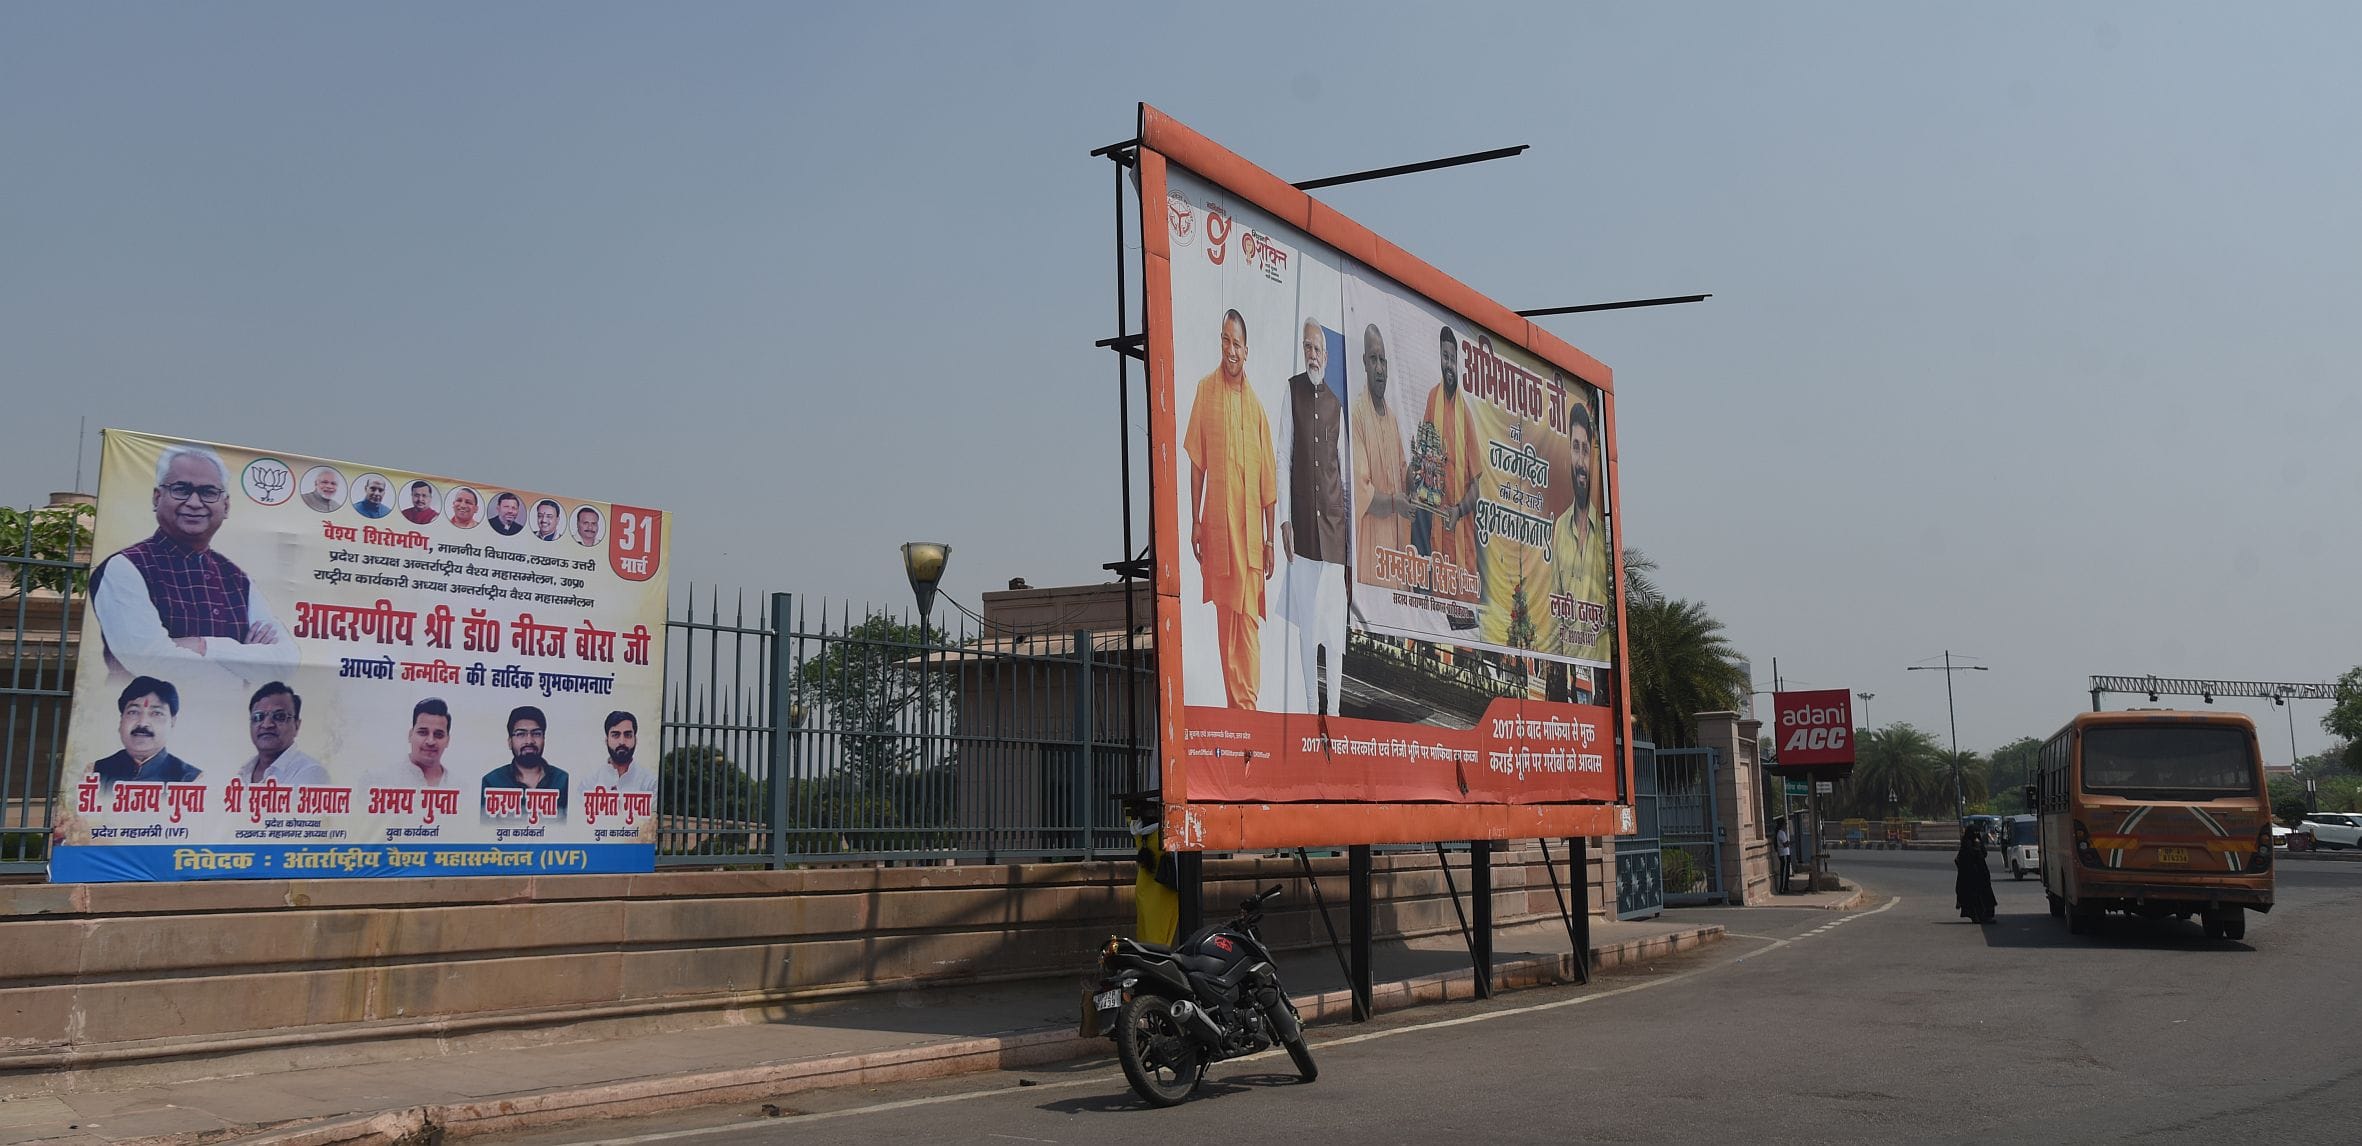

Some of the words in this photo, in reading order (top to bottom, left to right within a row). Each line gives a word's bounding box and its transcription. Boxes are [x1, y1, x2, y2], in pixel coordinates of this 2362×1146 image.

[1461, 334, 1543, 423] अभिभावक
[1546, 371, 1567, 436] जी
[1489, 440, 1549, 487] जन्मदिन
[322, 520, 358, 542] वैश्य
[437, 543, 482, 558] माननीय
[572, 559, 596, 572] उत्तरी
[618, 512, 653, 553] 31
[329, 549, 359, 563] प्रदेश
[362, 555, 400, 567] अध्यक्ष
[403, 558, 463, 577] अन्तर्राष्ट्रीय
[466, 563, 489, 578] वैश्य
[620, 555, 648, 575] मार्च
[1375, 544, 1430, 590] अम्बरीश
[1431, 551, 1457, 596] सिंह
[314, 567, 352, 585] राष्ट्रीय
[355, 572, 409, 589] कार्यकारी
[411, 580, 448, 592] अध्यक्ष
[450, 583, 507, 601] अन्तर्राष्ट्रीय
[510, 587, 532, 602] वैश्य
[534, 591, 595, 608] महासम्मेलन
[1549, 591, 1575, 620] लकी
[1577, 601, 1606, 633] ठाकुर
[294, 599, 417, 646] आदरणीय
[424, 604, 455, 650] श्री
[510, 612, 568, 659] नीरज
[574, 619, 617, 663] बोरा
[622, 624, 651, 666] जी
[339, 655, 396, 680] आपको
[400, 658, 461, 685] जन्मदिन
[465, 662, 487, 687] की
[491, 664, 535, 690] हार्दिक
[538, 672, 615, 697] शुभकामनाएं
[1492, 718, 1514, 739] 2017
[1515, 713, 1525, 739] के
[1526, 720, 1542, 740] बाद
[1543, 715, 1571, 741] माफिया
[1571, 717, 1579, 741] से
[1580, 723, 1595, 749] मुक्त
[1782, 702, 1846, 726] adani
[1301, 737, 1321, 752] 2017
[1330, 735, 1349, 756] पहले
[1350, 738, 1377, 756] सरकारी
[1378, 738, 1390, 758] एवं
[1390, 739, 1407, 758] निजी
[1407, 740, 1420, 764] भूमि
[1420, 745, 1430, 760] पर
[1430, 743, 1452, 762] माफिया
[1784, 727, 1846, 751] ACC
[1489, 746, 1514, 775] कराई
[1515, 746, 1530, 781] भूमि
[1531, 752, 1542, 773] पर
[1543, 747, 1565, 773] गरीबों
[1566, 747, 1577, 773] को
[1578, 754, 1603, 773] आवास
[78, 775, 102, 813] डॉ.
[112, 782, 163, 813] अजय
[167, 784, 207, 823] गुप्ता
[223, 777, 244, 813] श्री
[248, 778, 293, 823] सुनील
[297, 786, 352, 815] अग्रवाल
[421, 788, 460, 824] गुप्ता
[486, 790, 522, 815] करण
[526, 791, 559, 825] गुप्ता
[584, 785, 619, 825] सुमित
[623, 793, 653, 825] गुप्ता
[91, 824, 117, 840] प्रदेश
[119, 824, 162, 839] महामंत्री
[165, 827, 189, 839] (IVF)
[264, 817, 283, 829] प्रदेश
[329, 830, 347, 840] (IVF)
[386, 828, 402, 842] युवा
[404, 825, 440, 837] कार्यकर्ता
[496, 828, 511, 842] युवा
[512, 826, 546, 837] कार्यकर्ता
[594, 829, 608, 842] युवा
[609, 827, 640, 838] कार्यकर्ता
[173, 848, 256, 871] निवेदक
[283, 848, 382, 872] अंतर्राष्ट्रीय
[387, 847, 428, 867] वैश्य
[433, 847, 533, 867] महासम्मेलन
[540, 850, 588, 870] (IVF)
